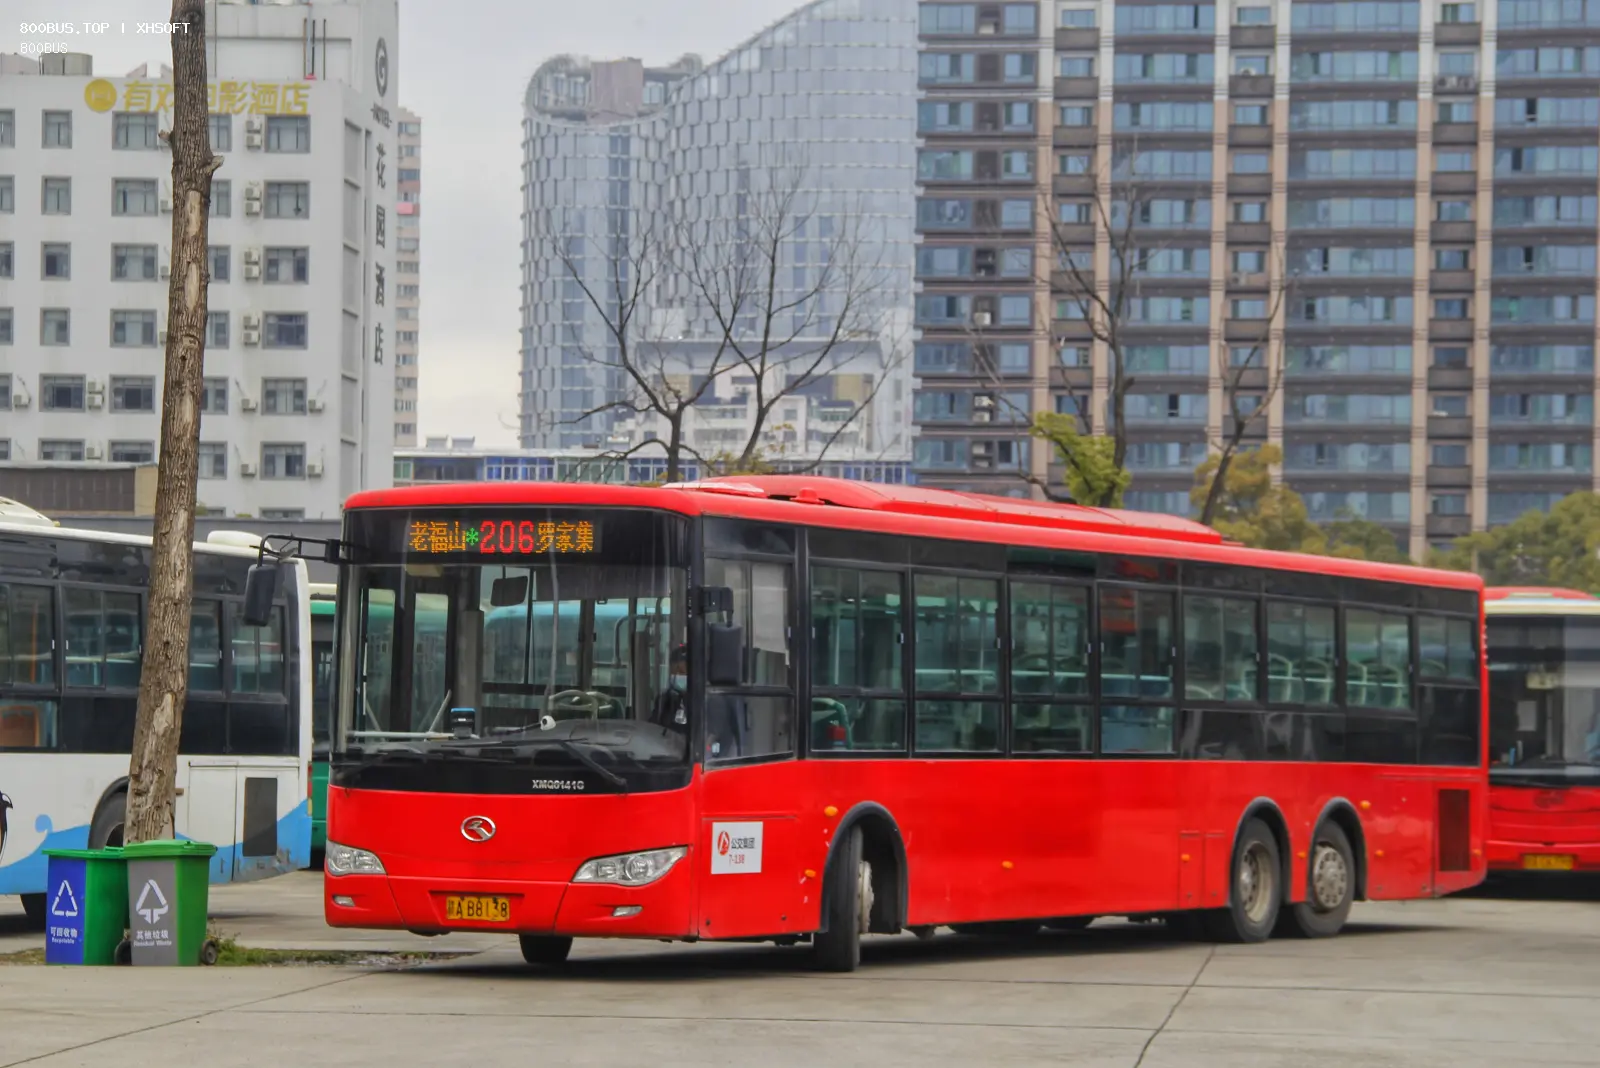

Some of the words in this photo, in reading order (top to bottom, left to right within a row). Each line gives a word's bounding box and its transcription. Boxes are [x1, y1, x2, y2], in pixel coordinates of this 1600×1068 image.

[409, 521, 466, 554] 老福山
[480, 520, 534, 554] 206
[536, 521, 594, 554] 罗家集
[50, 926, 78, 938] 可回收物
[136, 930, 169, 940] 其他垃圾
